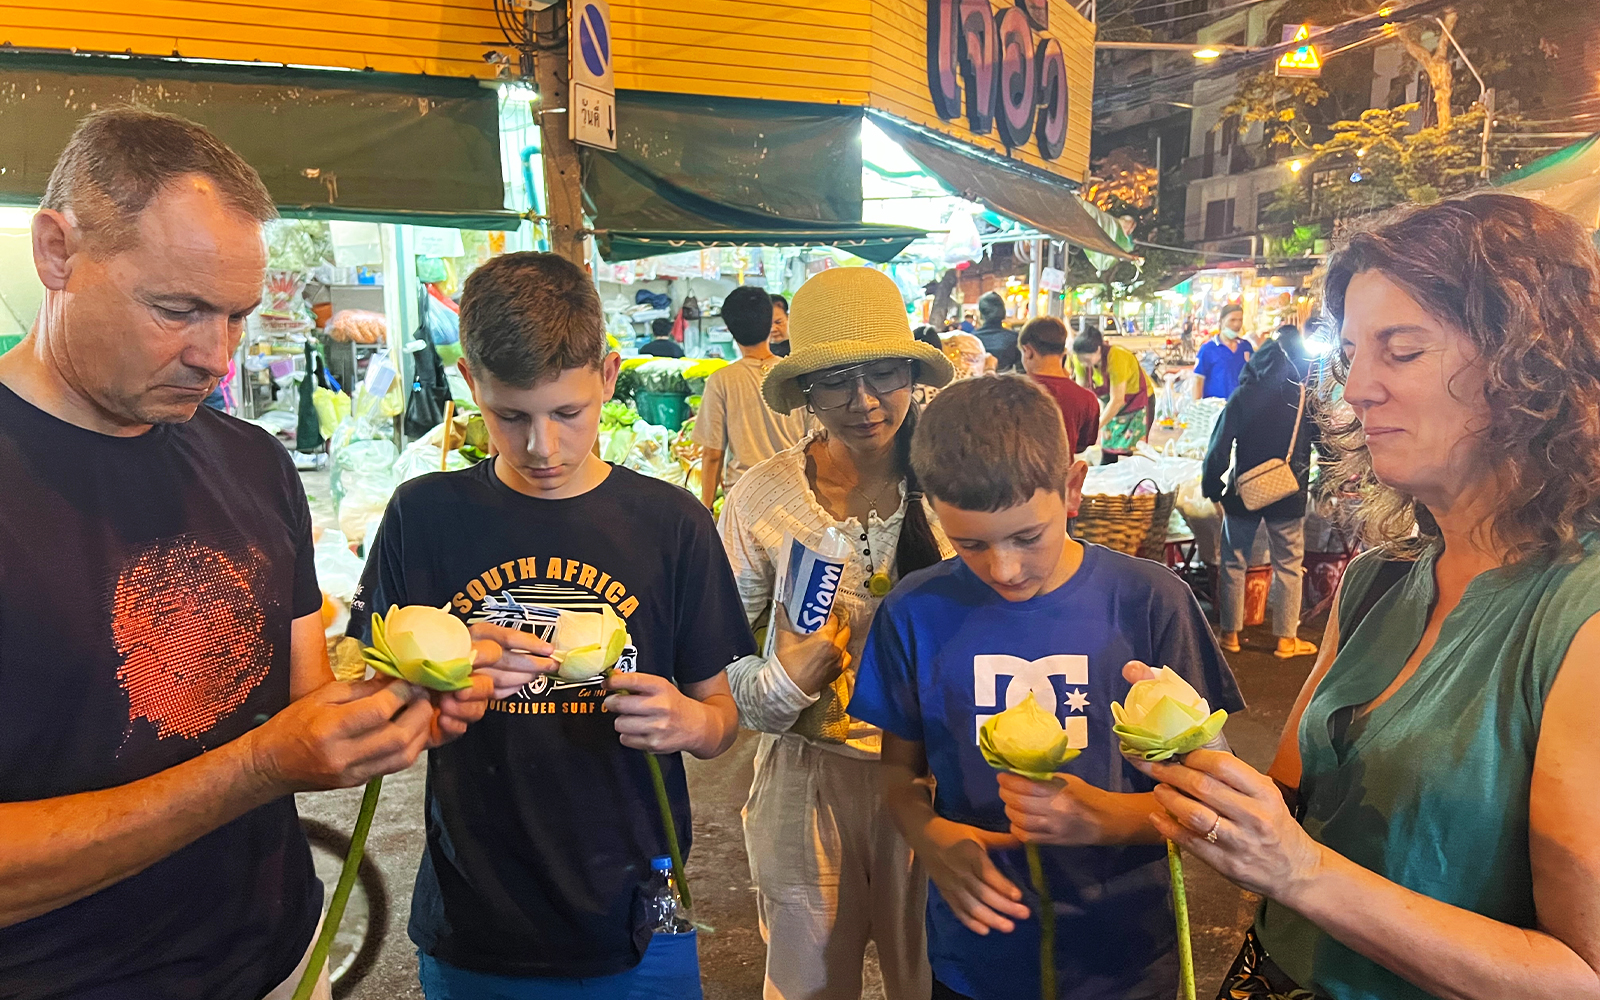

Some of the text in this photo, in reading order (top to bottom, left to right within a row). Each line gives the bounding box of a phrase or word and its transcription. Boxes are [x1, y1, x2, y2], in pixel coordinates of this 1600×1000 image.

[453, 557, 640, 619] SOUTH AFRICA
[803, 565, 841, 630] Siam
[487, 701, 556, 714] UIKSILVER
[562, 702, 595, 714] SURF
